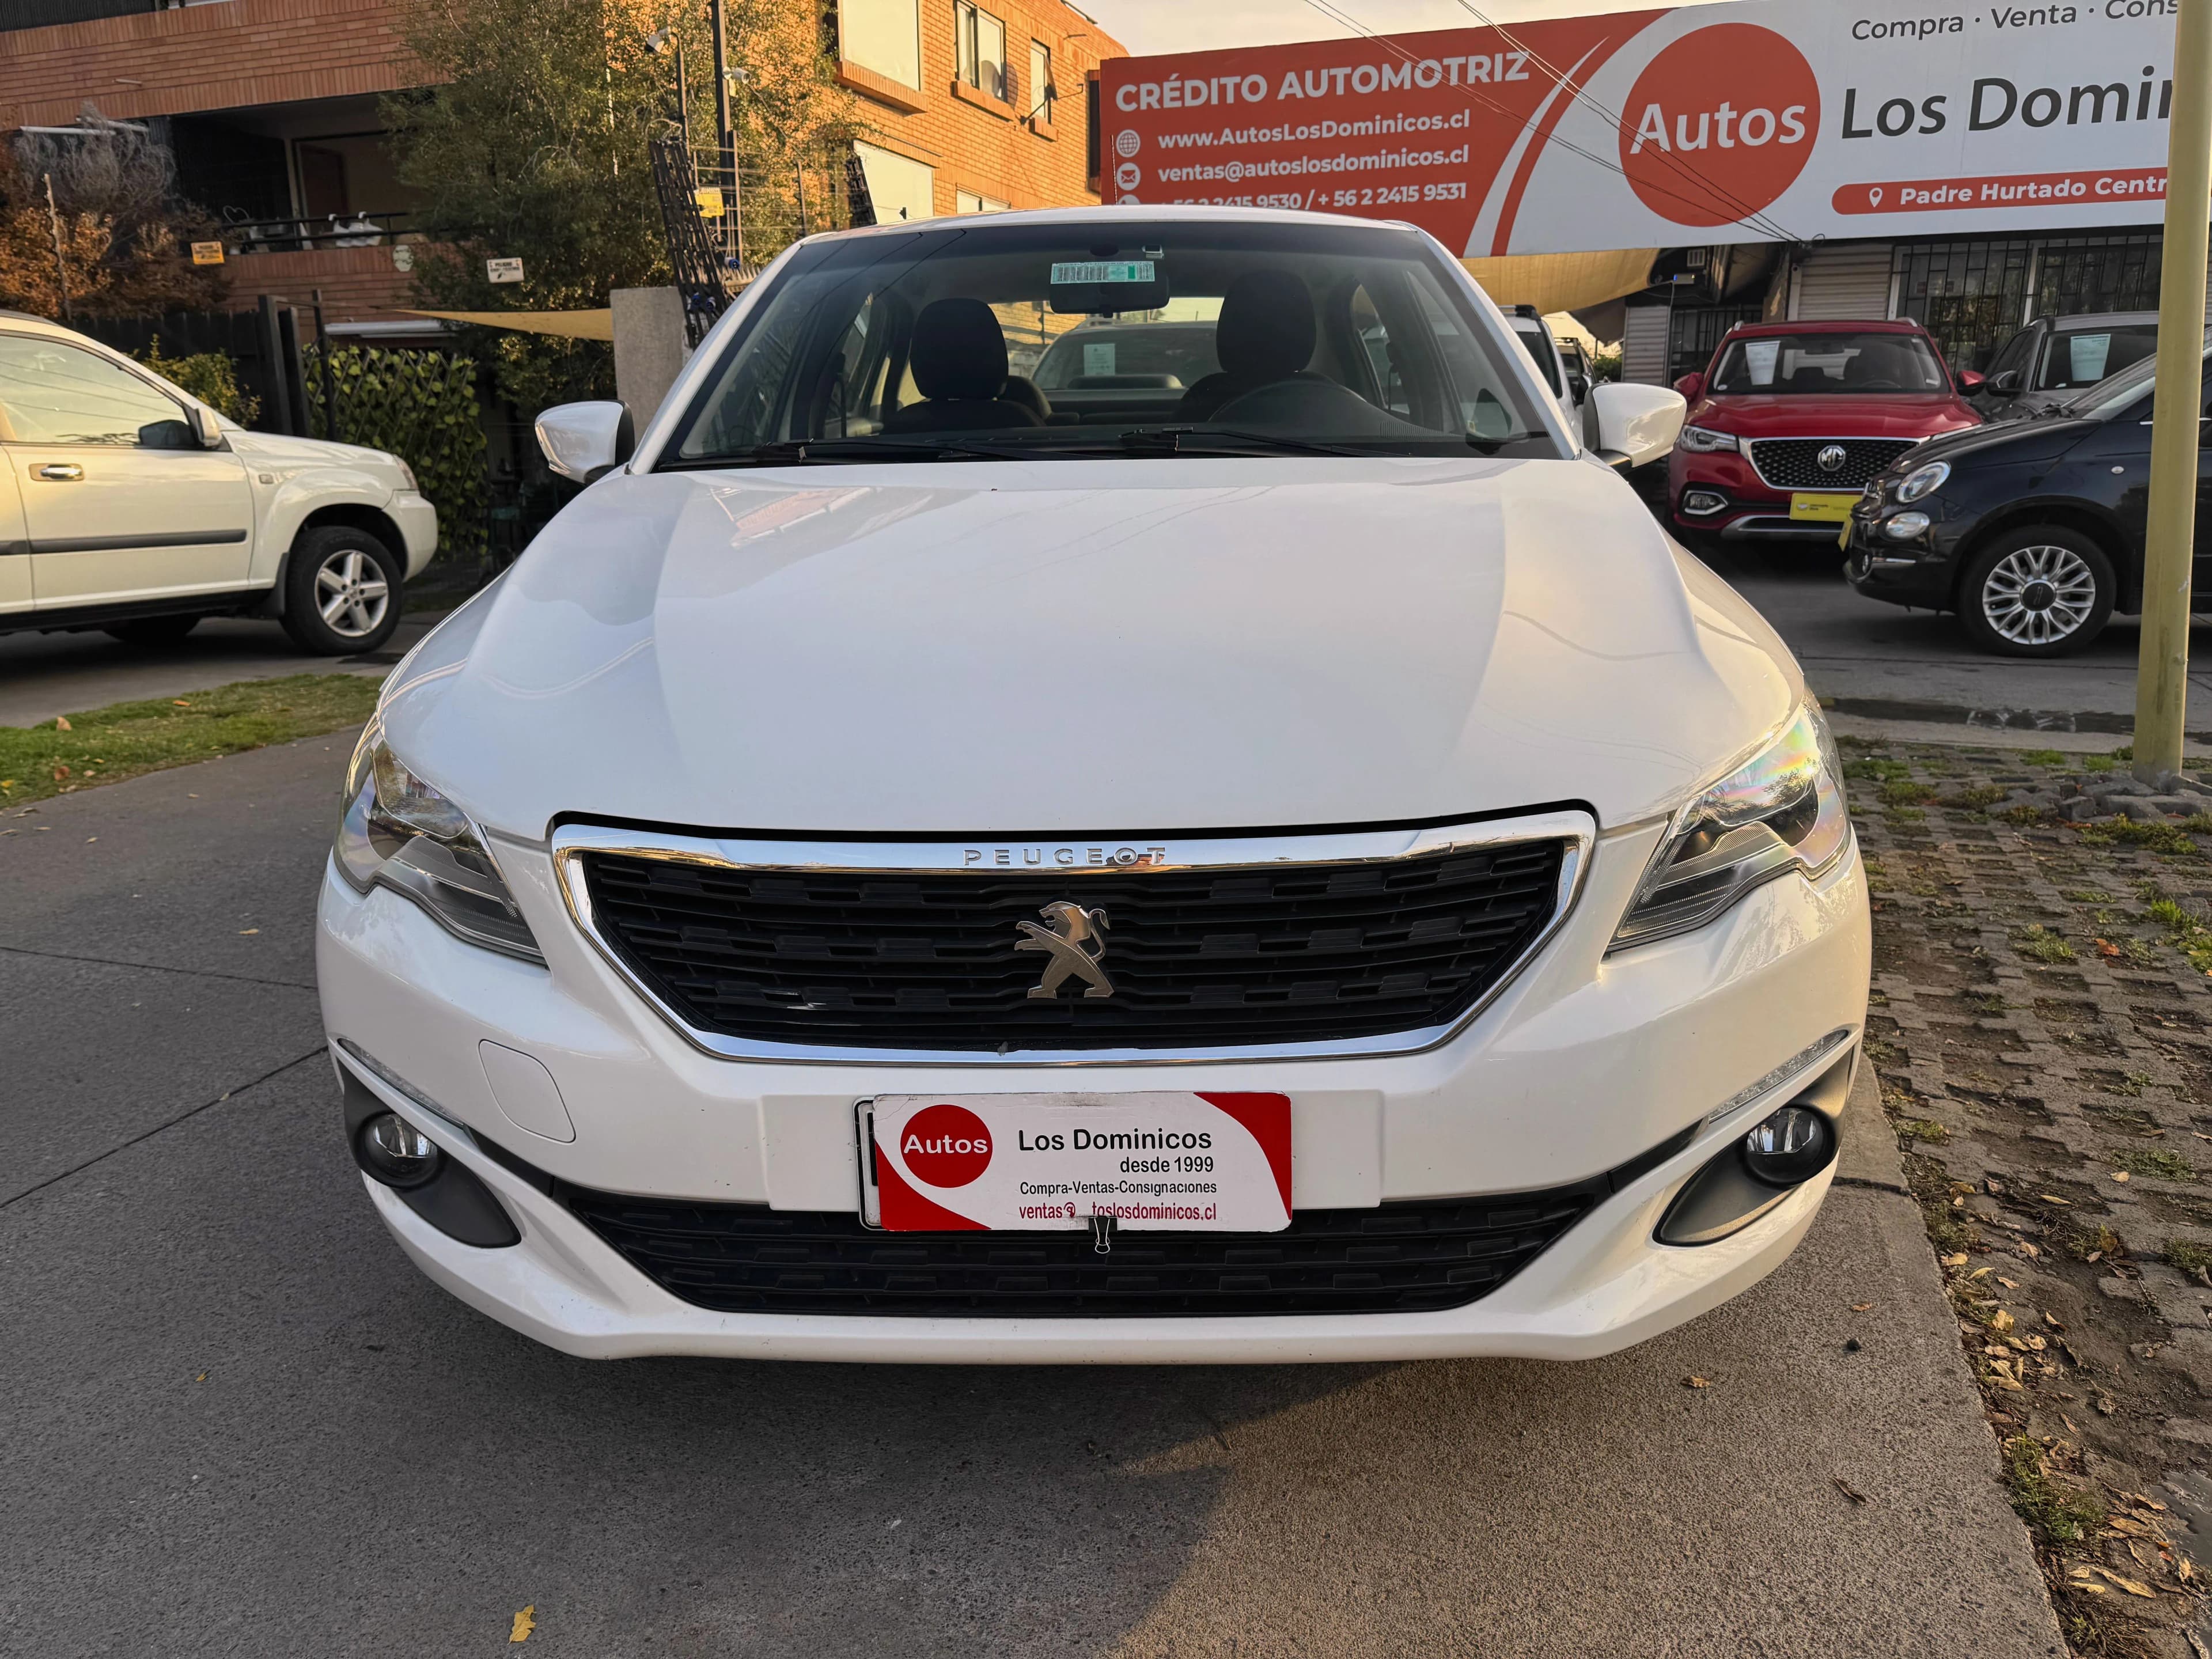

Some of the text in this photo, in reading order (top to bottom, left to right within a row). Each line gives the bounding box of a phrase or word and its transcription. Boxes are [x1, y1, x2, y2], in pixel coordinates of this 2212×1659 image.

[1852, 17, 1963, 41] Compra
[1991, 5, 2077, 29] Venta
[1116, 51, 1530, 112] CRÉDITO AUTOMOTRIZ
[1842, 65, 2173, 139] Los Domi
[1158, 109, 1470, 149] www.AutosLosDominicos.cl
[1629, 101, 1806, 154] Autos
[1158, 145, 1469, 183] ventas@autoslosdominicos.cl
[1256, 193, 1302, 209] 9530
[1333, 190, 1358, 207] 56
[1361, 188, 1373, 205] 2
[1376, 185, 1419, 204] 2415
[1423, 182, 1467, 202] 9531
[1900, 182, 1972, 205] Padre
[1980, 177, 2086, 201] Hurtado
[963, 847, 1166, 866] PEUGEOT
[903, 1134, 988, 1154] Autos
[1018, 1127, 1212, 1151] Los Dominicos
[1120, 1156, 1214, 1173] desde 1999
[1020, 1180, 1217, 1198] Compra-Ventas-Consignaciones
